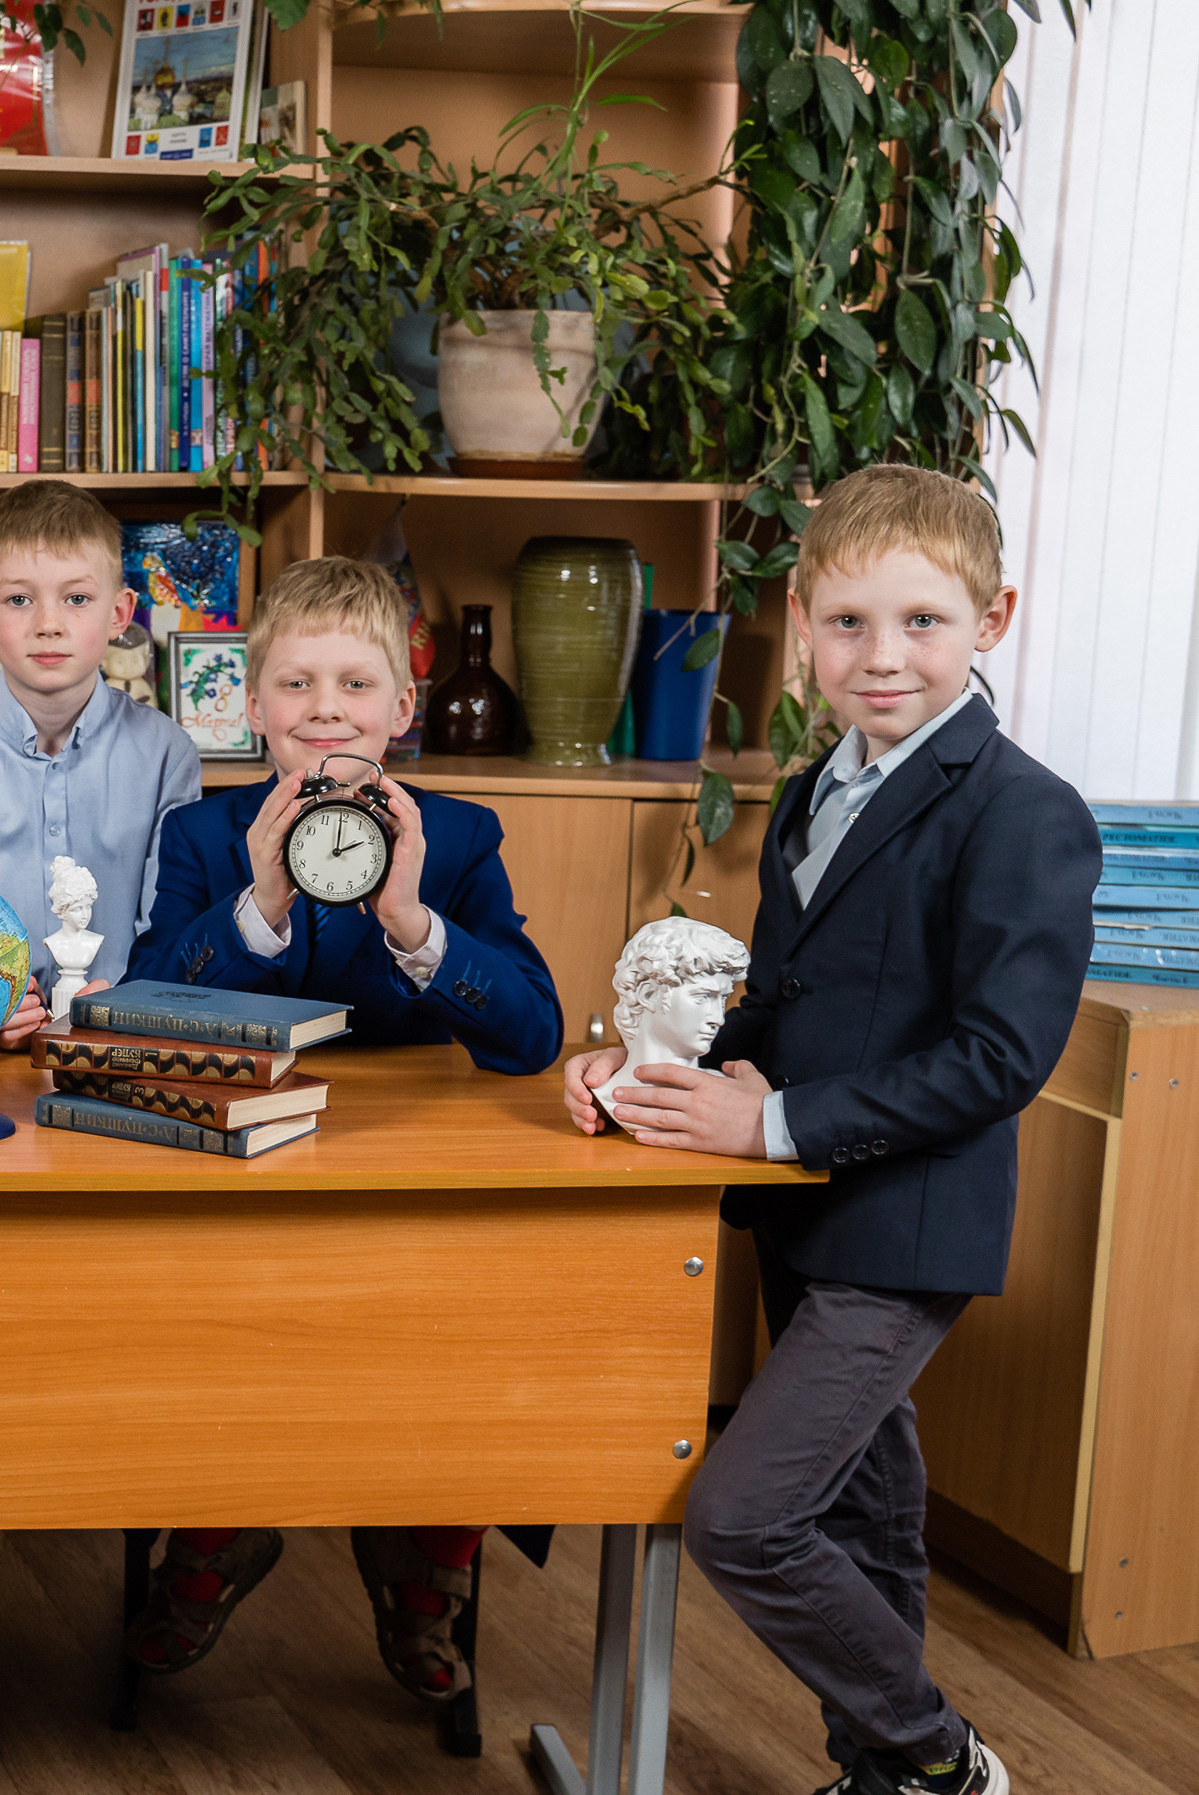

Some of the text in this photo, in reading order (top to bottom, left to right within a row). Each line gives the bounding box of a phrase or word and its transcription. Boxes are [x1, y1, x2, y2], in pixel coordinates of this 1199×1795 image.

[214, 683, 232, 712] 8
[320, 815, 330, 826] 11
[305, 825, 316, 836] 10
[367, 835, 376, 846] 2
[1102, 832, 1175, 844] РЕСТОМАТИЯ
[296, 841, 304, 850] 9
[298, 859, 306, 869] 8
[370, 853, 378, 864] 3
[311, 873, 319, 883] 7
[361, 869, 368, 879] 4
[326, 881, 334, 892] 6
[345, 880, 353, 890] 5
[111, 1048, 141, 1059] КУПЕР
